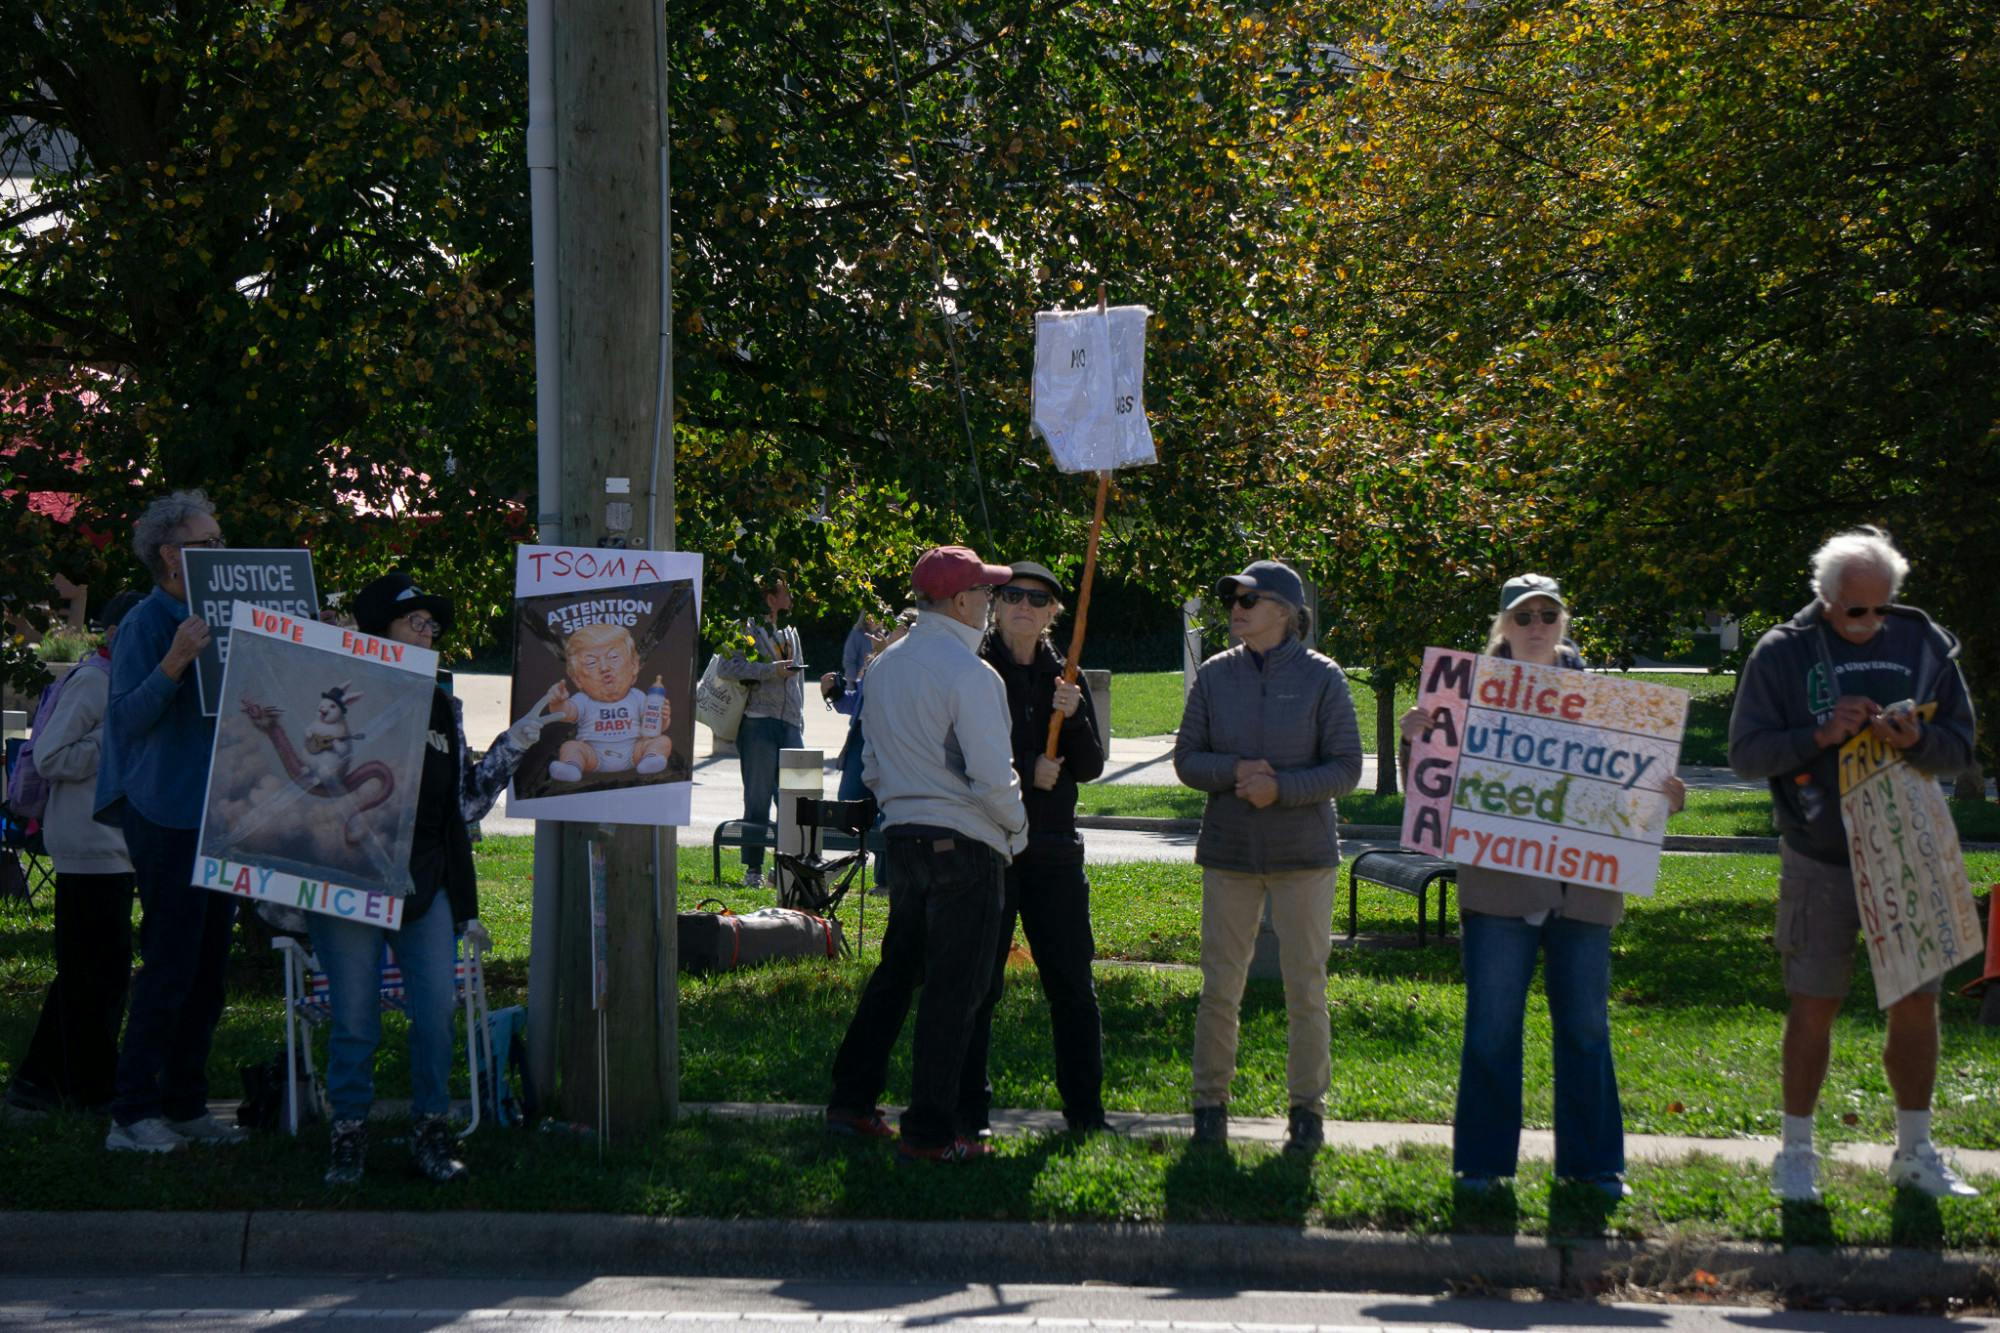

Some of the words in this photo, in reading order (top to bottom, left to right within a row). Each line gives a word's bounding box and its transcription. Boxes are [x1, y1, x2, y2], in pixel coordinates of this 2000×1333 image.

[208, 564, 296, 592] JUSTICE
[528, 551, 661, 584] TSOMA
[547, 599, 653, 626] ATTENTION
[563, 613, 638, 635] SEEKING
[252, 608, 304, 643] VOTE
[342, 631, 405, 663] EARLY
[594, 719, 633, 733] BABY
[600, 707, 629, 720] BIG
[202, 857, 274, 896] PLAY
[296, 880, 396, 924] NICE!
